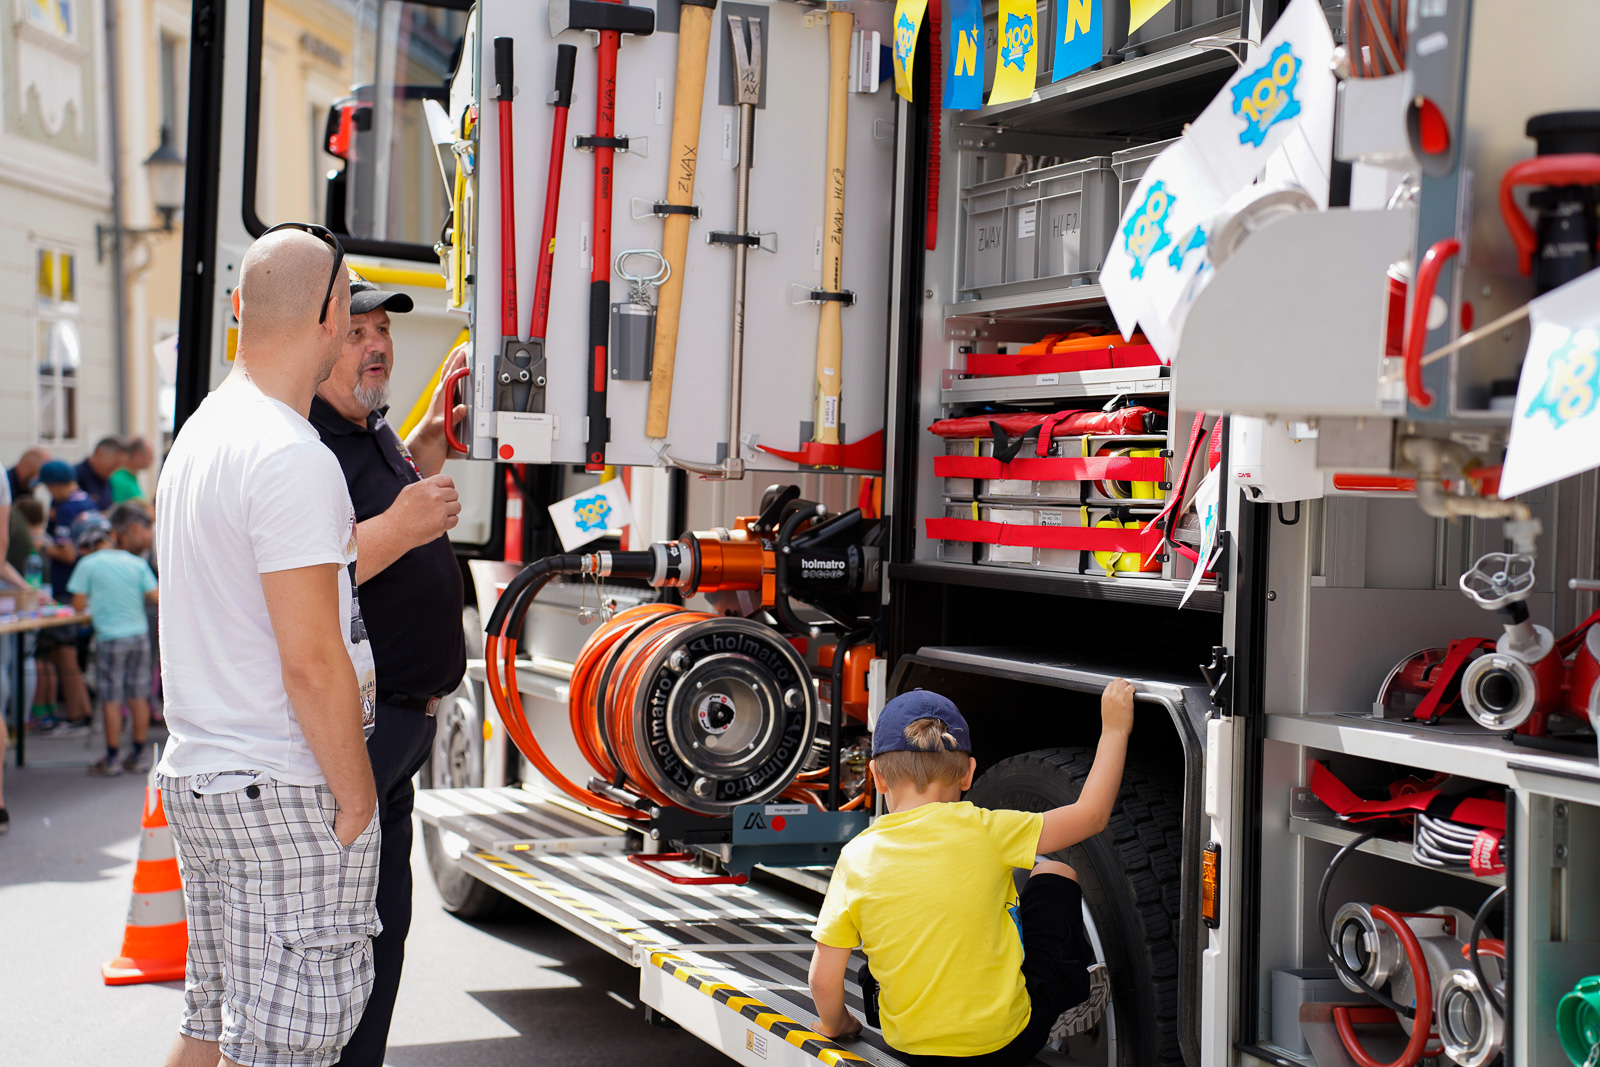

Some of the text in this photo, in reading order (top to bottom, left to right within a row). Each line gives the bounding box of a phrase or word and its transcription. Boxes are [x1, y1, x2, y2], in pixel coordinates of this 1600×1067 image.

[898, 26, 913, 49] 100
[954, 30, 978, 76] N
[1007, 24, 1031, 49] 100
[602, 74, 616, 123] ZWAX
[1241, 53, 1296, 121] 100
[678, 144, 697, 193] ZWAX
[831, 208, 844, 245] ZWAX
[978, 226, 1002, 252] ZWAX
[1052, 212, 1078, 238] HLF2
[1128, 190, 1168, 255] 100
[578, 499, 608, 521] 100
[801, 559, 846, 569] holmatro
[712, 634, 789, 681] holmatro
[651, 677, 675, 771] holmatro
[724, 734, 798, 794] holmatro
